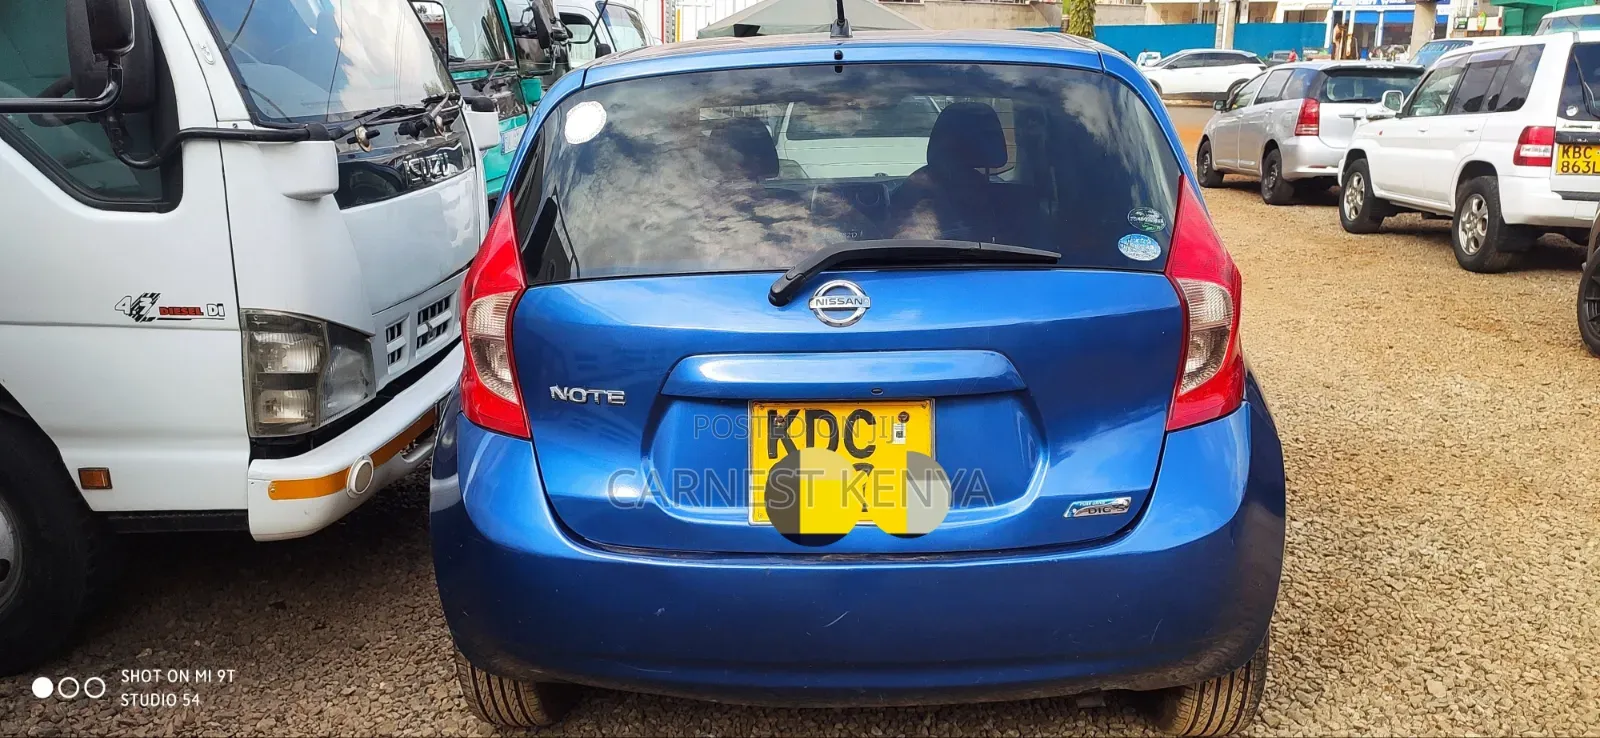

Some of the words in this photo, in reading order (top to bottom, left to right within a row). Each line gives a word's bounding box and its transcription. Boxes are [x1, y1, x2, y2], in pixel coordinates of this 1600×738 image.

[1562, 145, 1592, 159] KBC
[403, 152, 449, 186] ISUZU
[1561, 160, 1600, 174] 863L
[815, 297, 863, 306] NISSAN
[158, 306, 204, 316] DIESEL
[549, 385, 626, 406] NOTE
[767, 409, 876, 459] KDC
